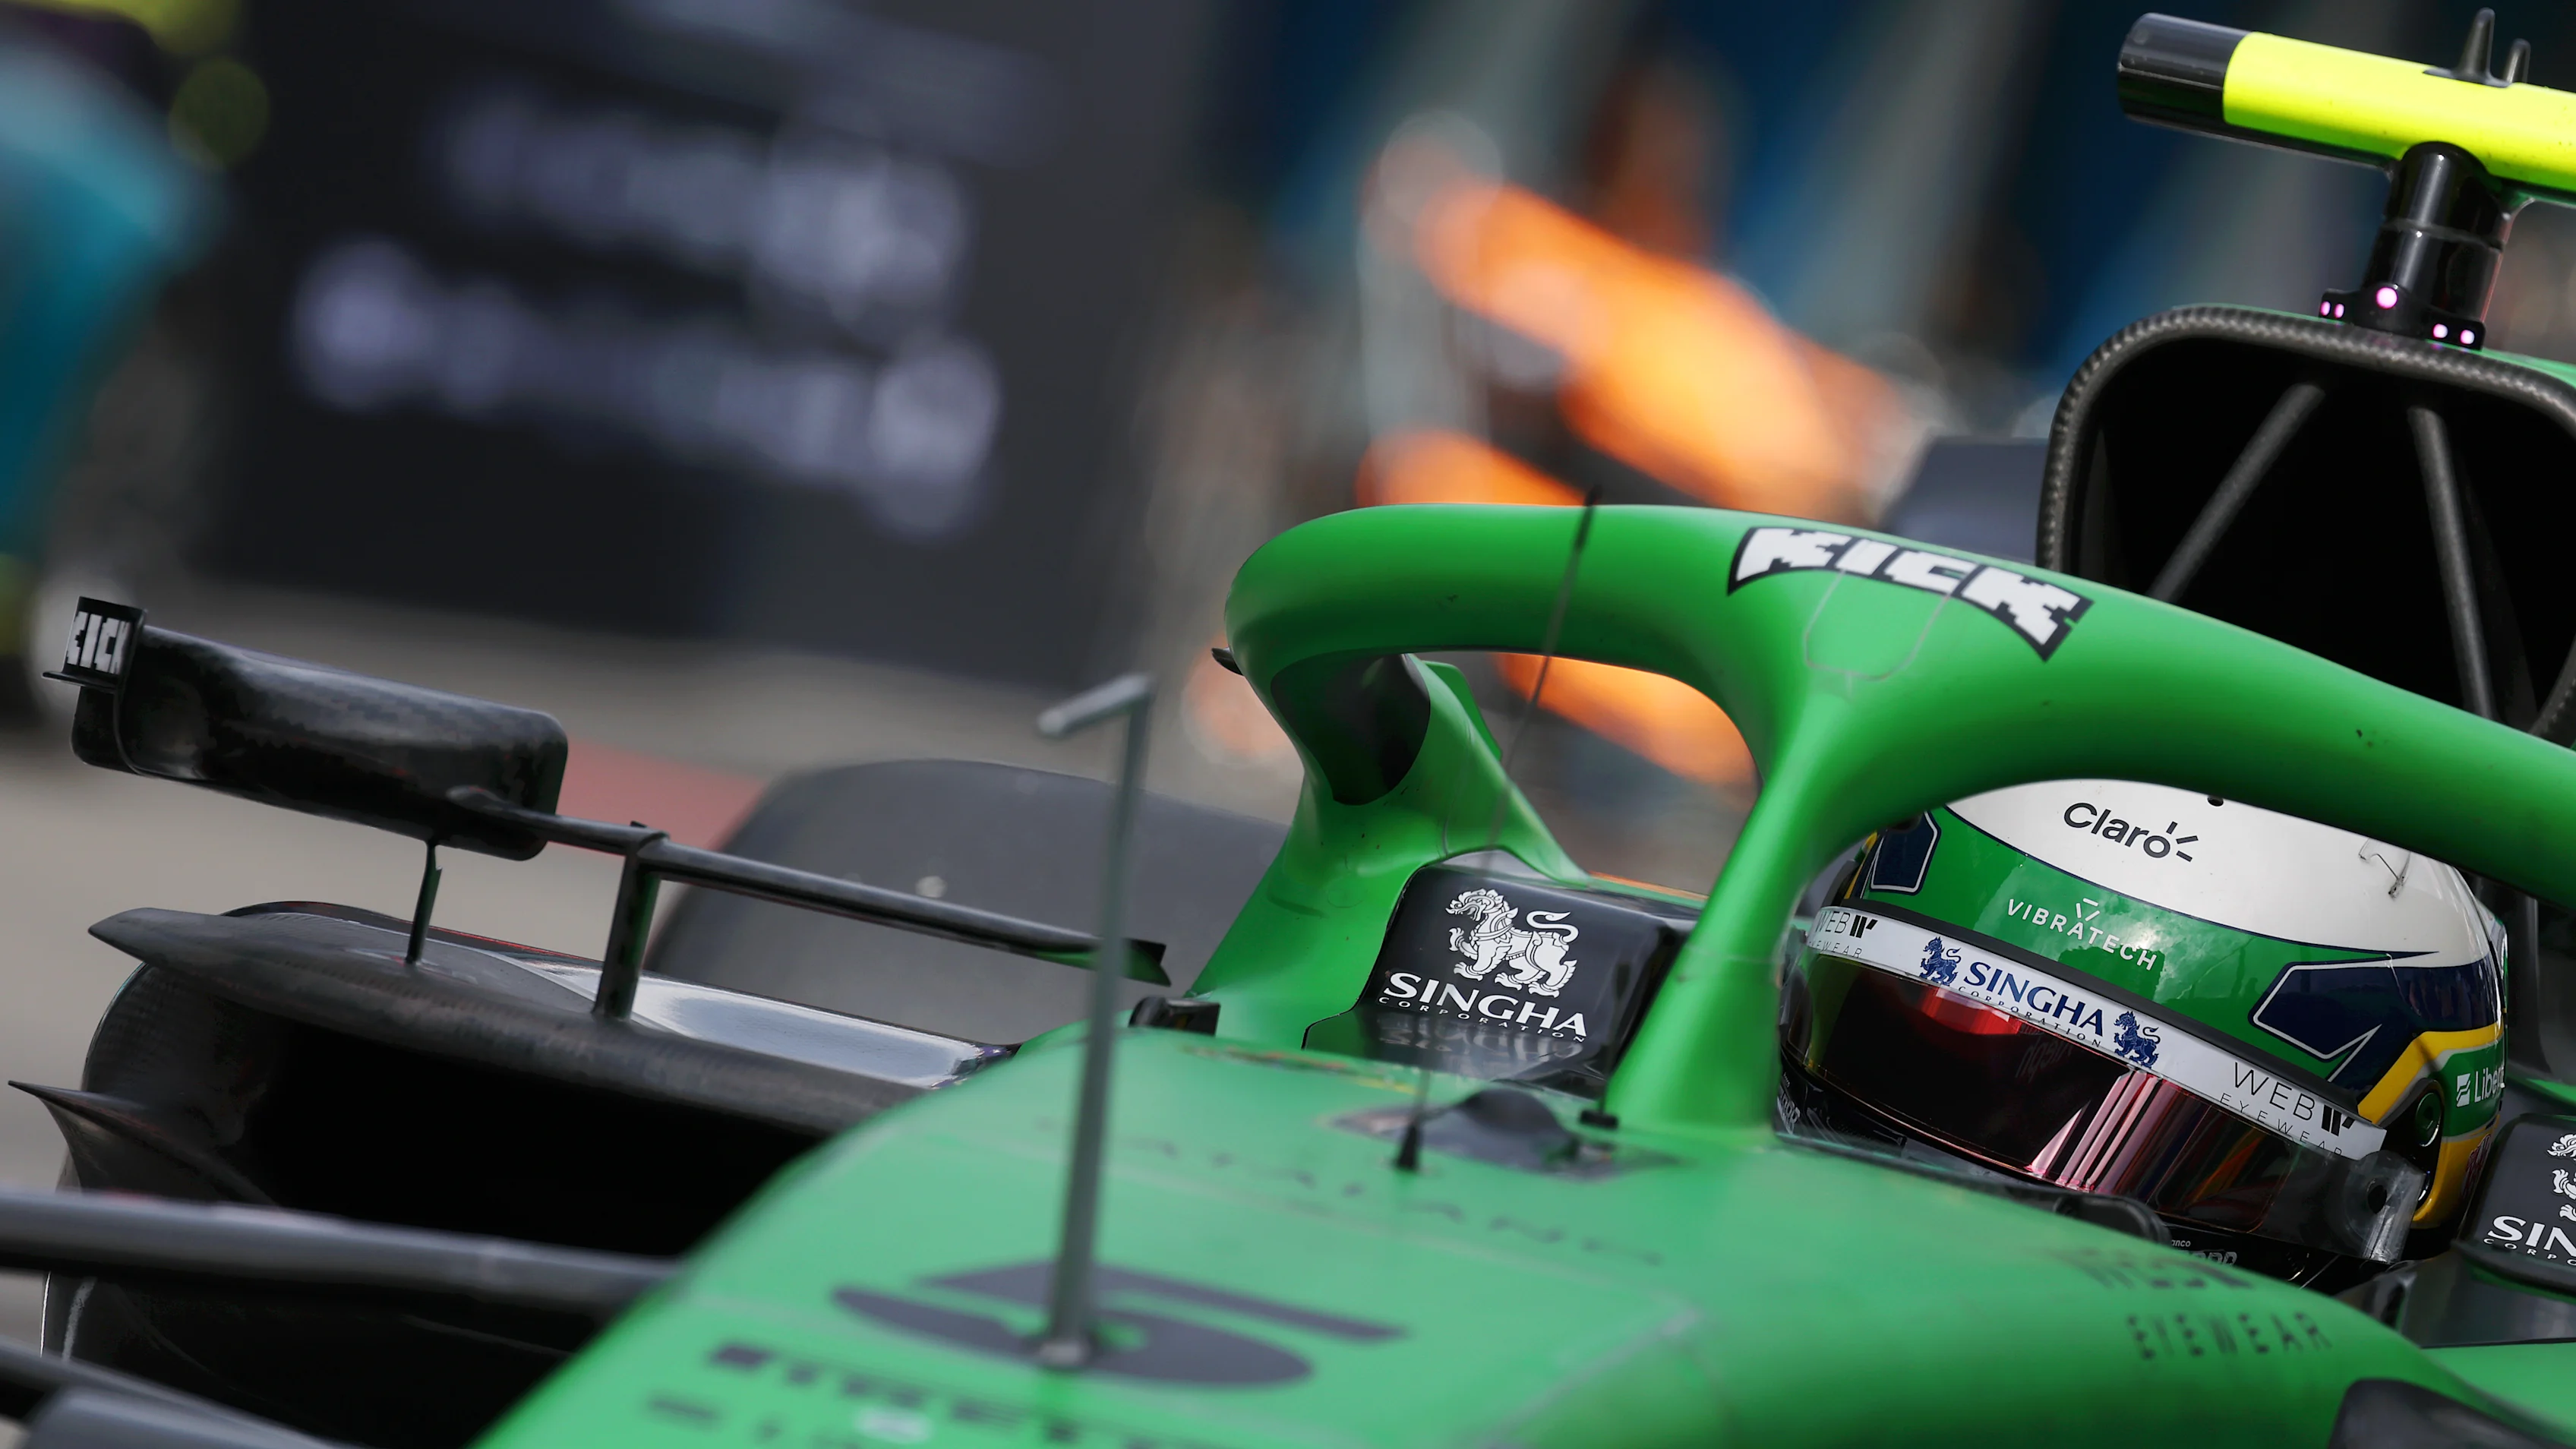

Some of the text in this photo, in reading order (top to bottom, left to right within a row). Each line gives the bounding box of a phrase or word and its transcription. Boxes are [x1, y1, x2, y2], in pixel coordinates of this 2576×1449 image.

[1734, 527, 2082, 648] KICK
[2063, 801, 2171, 859] Claro
[1815, 911, 1851, 934] WEB
[2007, 898, 2158, 971] VIBRATECH
[1378, 996, 1585, 1043] CORPORATION
[1383, 971, 1588, 1038] SINGHA
[1958, 986, 2101, 1048] CORPORATION
[1963, 961, 2104, 1037] SINGHA
[2233, 1061, 2316, 1122] WEB
[830, 1258, 1408, 1388] 5
